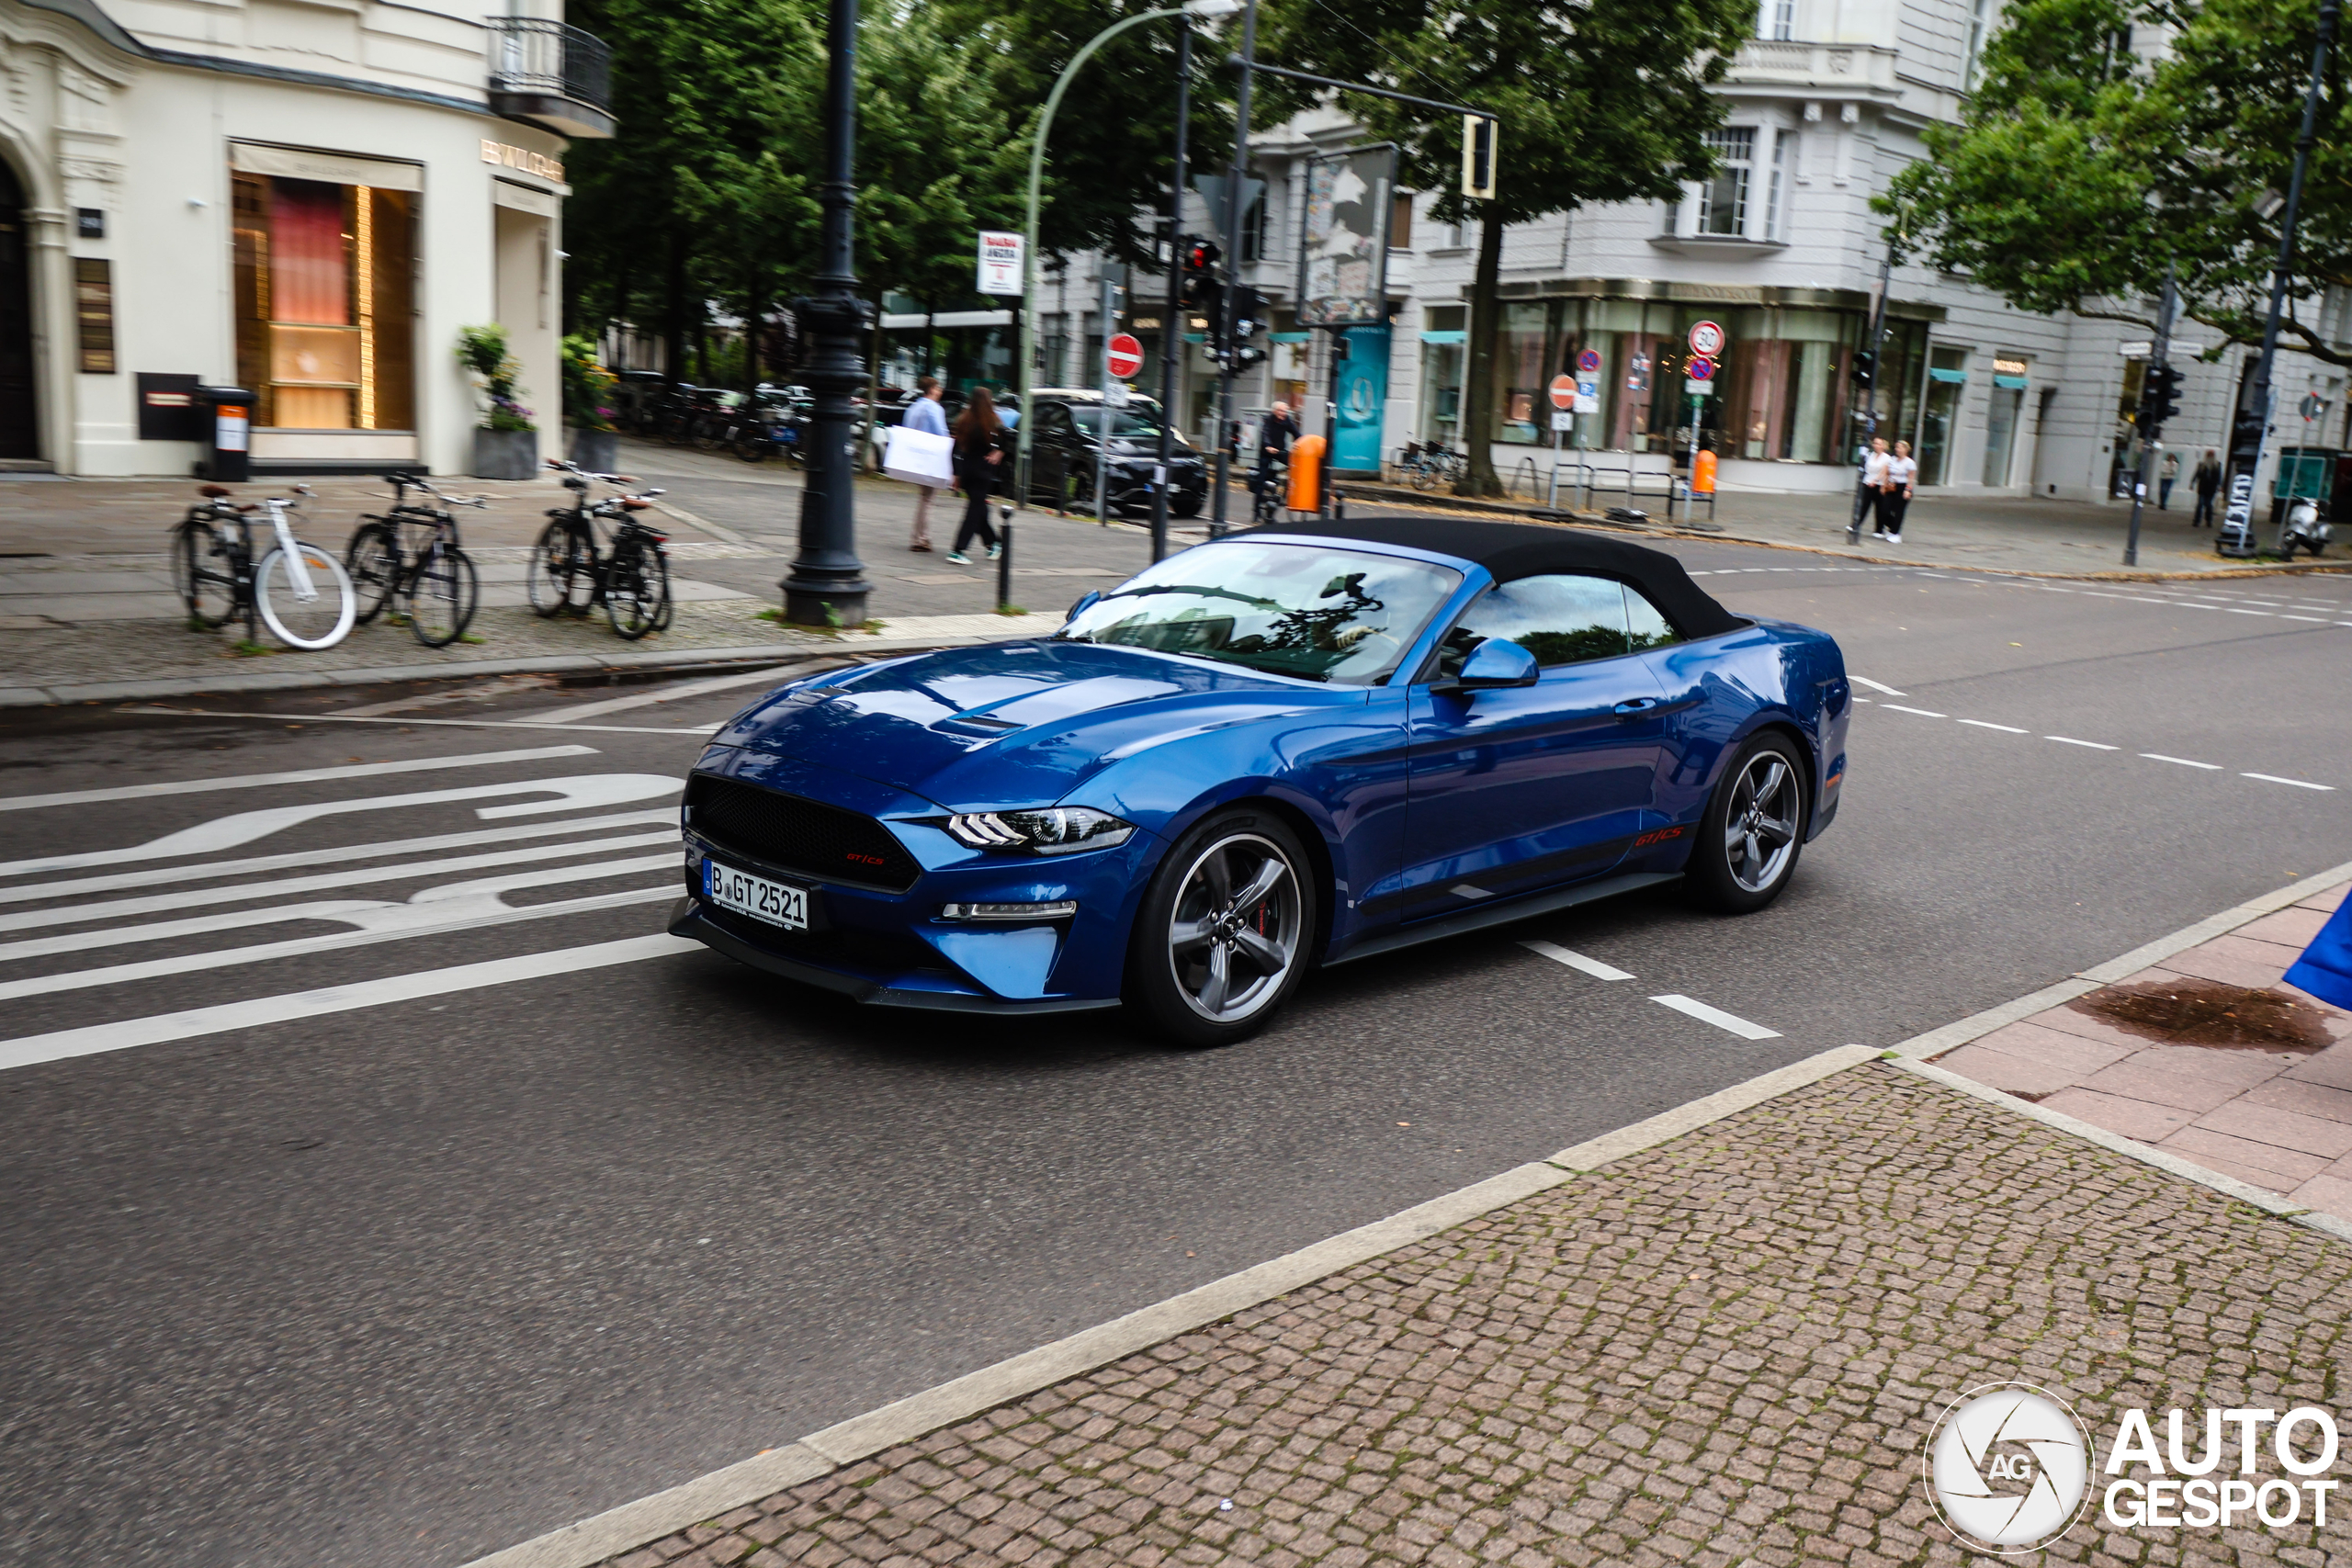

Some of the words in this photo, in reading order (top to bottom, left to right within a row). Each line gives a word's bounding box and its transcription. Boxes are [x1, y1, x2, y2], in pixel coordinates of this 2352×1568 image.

[1696, 330, 1718, 346] 30
[1635, 826, 1684, 847] GT/CS
[846, 853, 885, 865] GT/CS
[706, 880, 710, 889] D
[713, 866, 722, 895] B
[733, 874, 754, 907] GT
[759, 883, 804, 923] 2521
